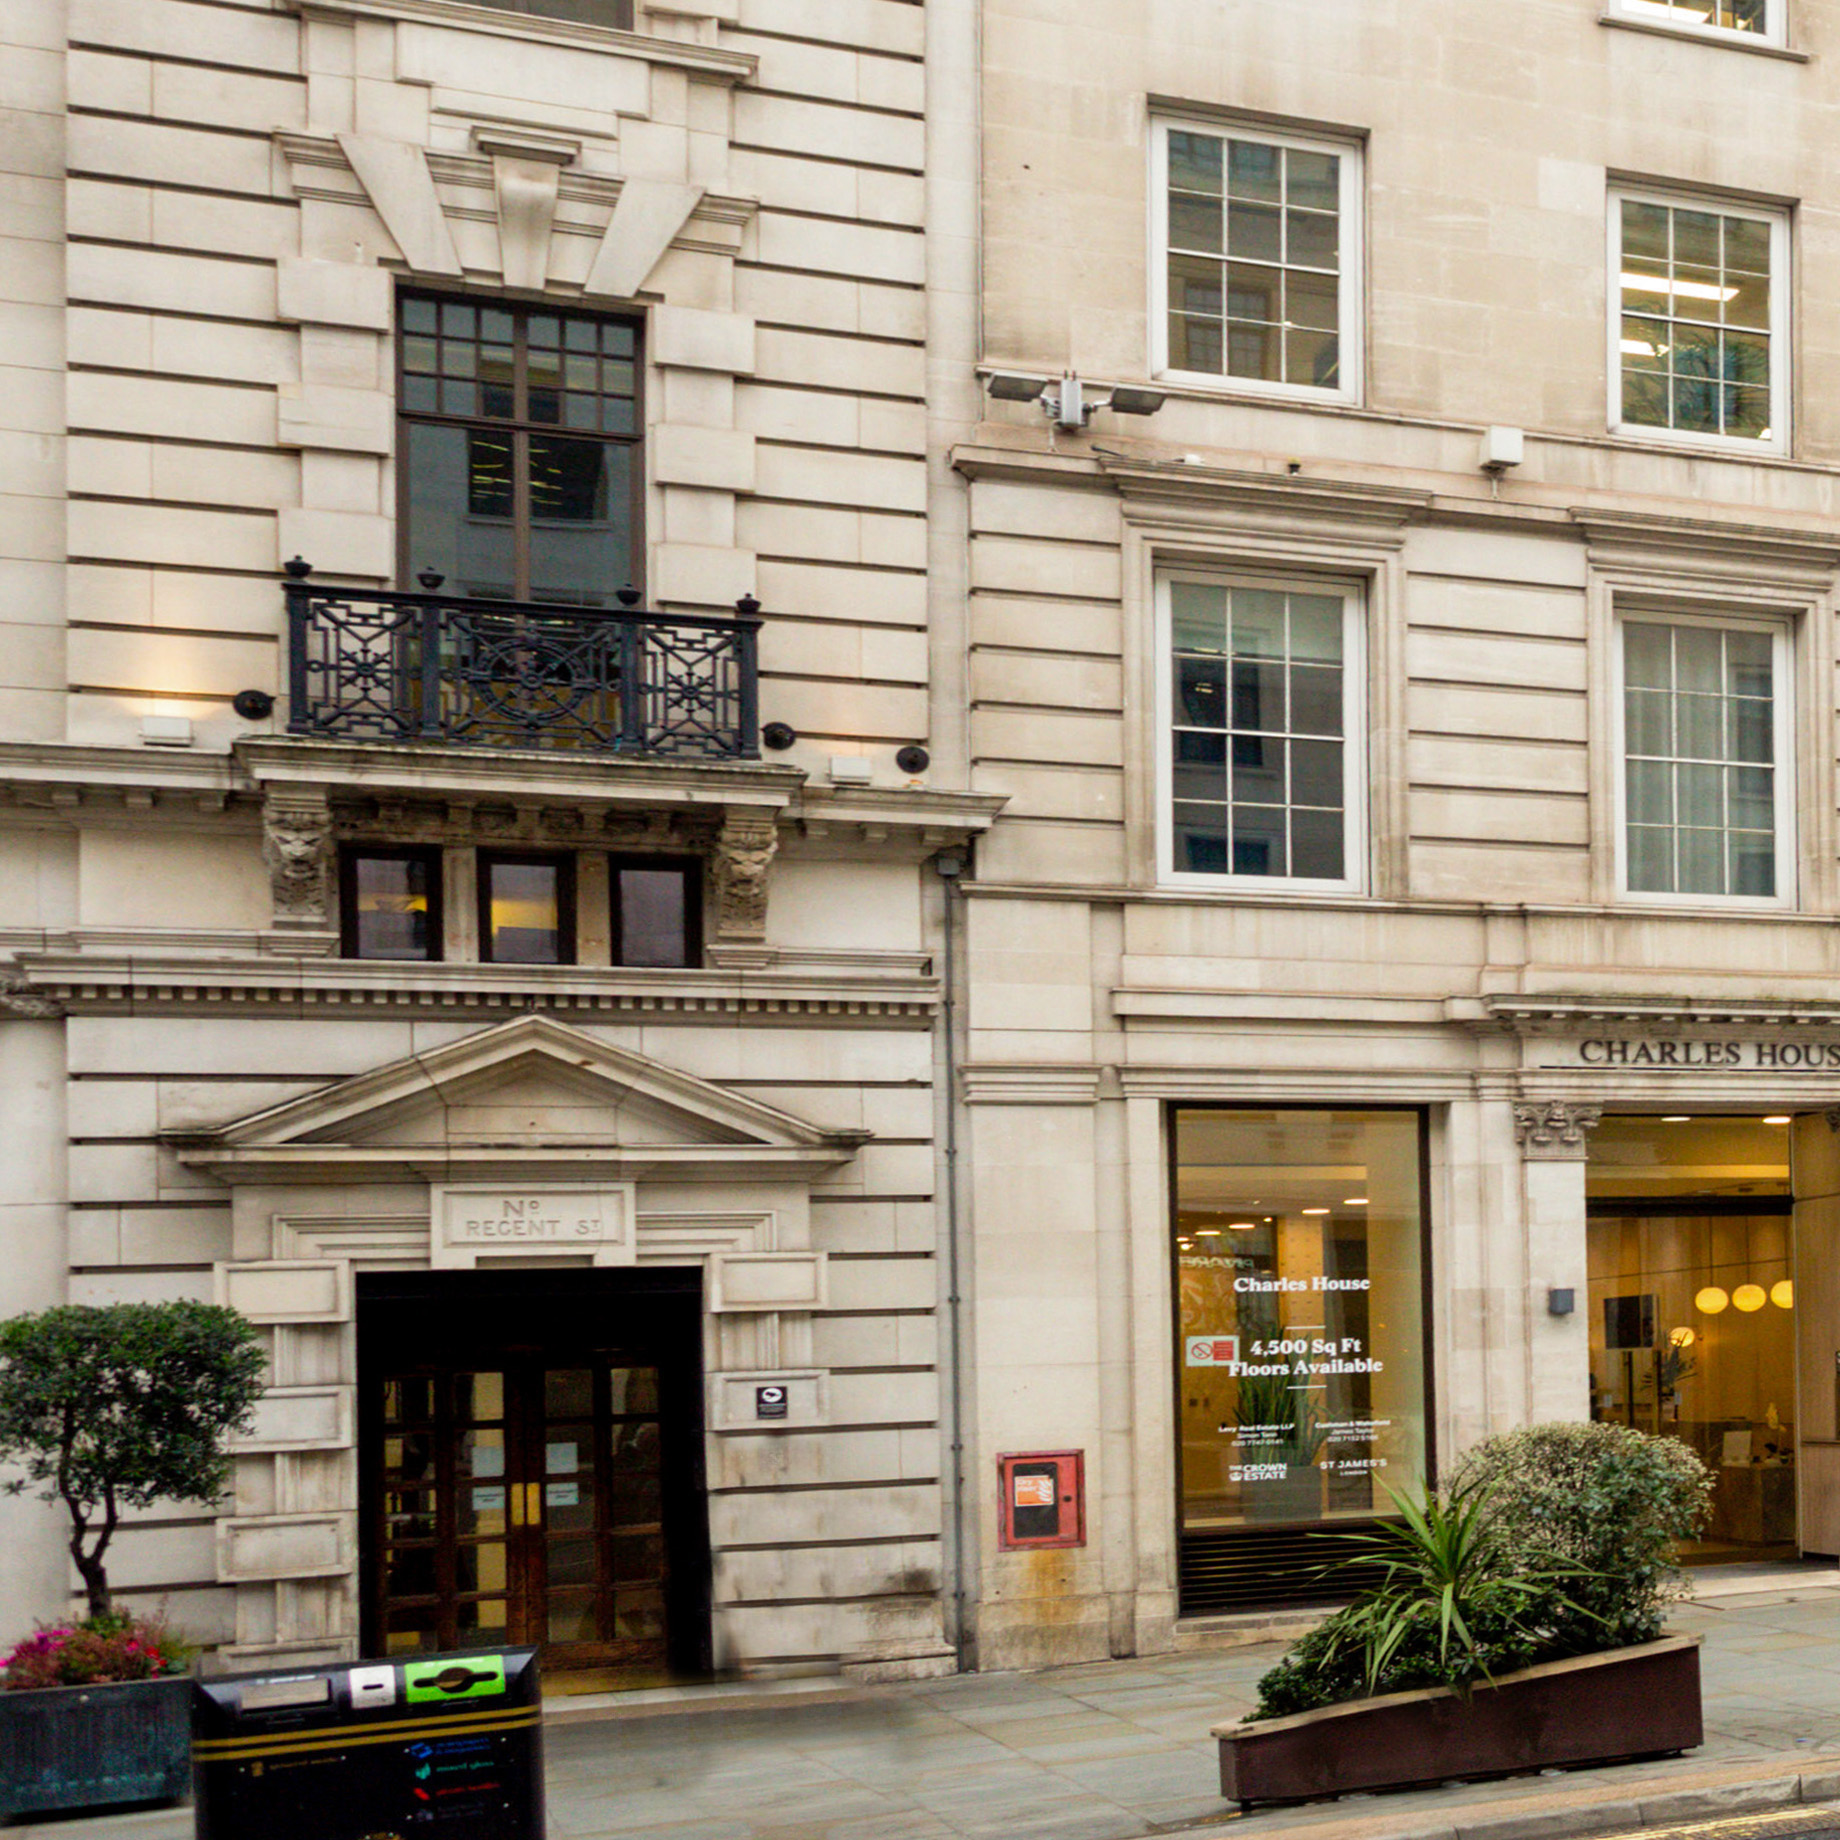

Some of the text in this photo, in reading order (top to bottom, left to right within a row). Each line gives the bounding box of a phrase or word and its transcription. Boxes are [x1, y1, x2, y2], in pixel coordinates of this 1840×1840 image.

[1579, 1040, 1741, 1065] CHARLES
[466, 1220, 560, 1236] REGENT
[1233, 1276, 1371, 1292] Charles House
[1251, 1339, 1307, 1357] 4,500
[1311, 1339, 1336, 1356] Sq
[1341, 1338, 1362, 1353] Ft
[1228, 1358, 1383, 1377] Floors Available
[1243, 1463, 1287, 1472] CROWN
[1320, 1458, 1388, 1470] ST JAMES'S
[1244, 1472, 1287, 1481] ESTATE
